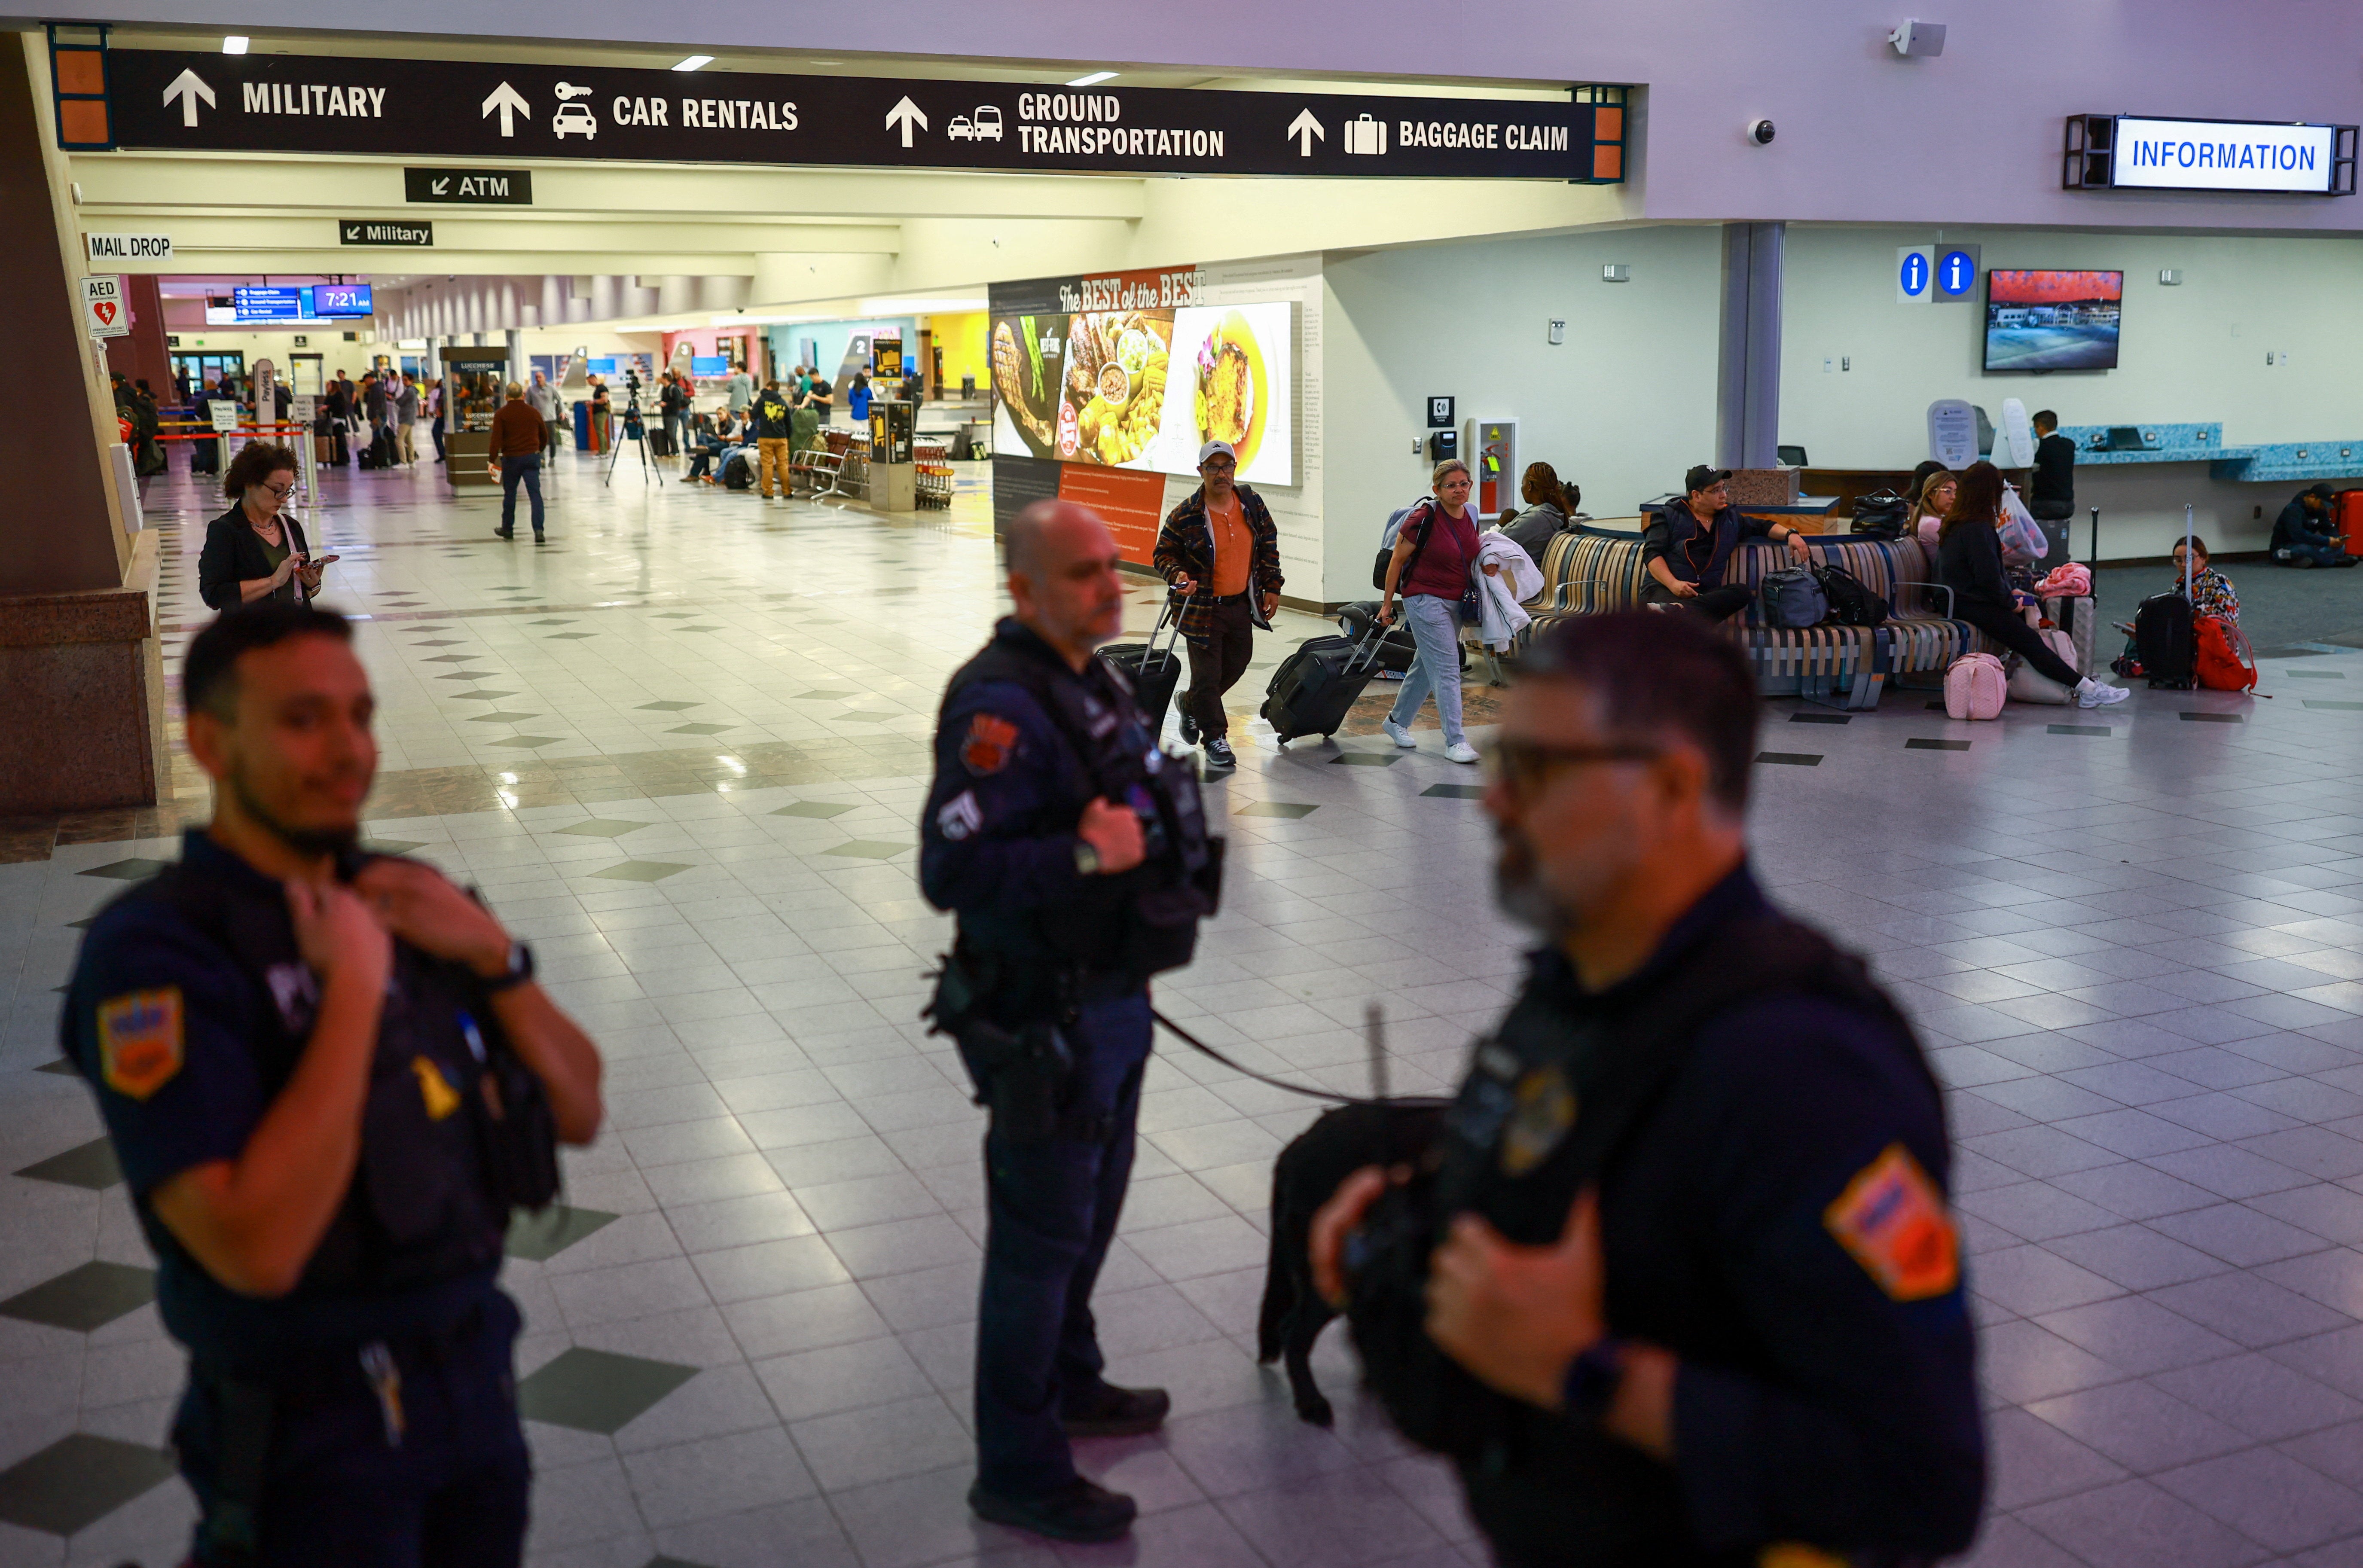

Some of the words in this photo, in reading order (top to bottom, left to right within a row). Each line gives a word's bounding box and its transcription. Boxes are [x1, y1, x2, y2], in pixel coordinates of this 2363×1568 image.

[243, 82, 386, 118] MILITARY
[613, 96, 669, 126] CAR
[683, 98, 798, 131] RENTALS
[1018, 92, 1120, 122] GROUND
[1018, 125, 1224, 157] TRANSPORTATION
[1400, 121, 1498, 149] BAGGAGE
[1505, 124, 1568, 151] CLAIM
[2133, 140, 2315, 171] INFORMATION
[458, 177, 509, 197] ATM
[92, 237, 127, 257] MAIL
[131, 237, 170, 256] DROP
[366, 224, 429, 244] Military
[90, 281, 114, 296] AED
[325, 292, 357, 307] 7:21
[1059, 284, 1081, 312] The
[1081, 278, 1121, 311] BEST
[1121, 281, 1137, 310] of
[1136, 282, 1159, 308] the
[1160, 270, 1206, 307] BEST
[681, 344, 689, 356] 3
[856, 340, 866, 354] 2
[262, 370, 272, 402] Payless
